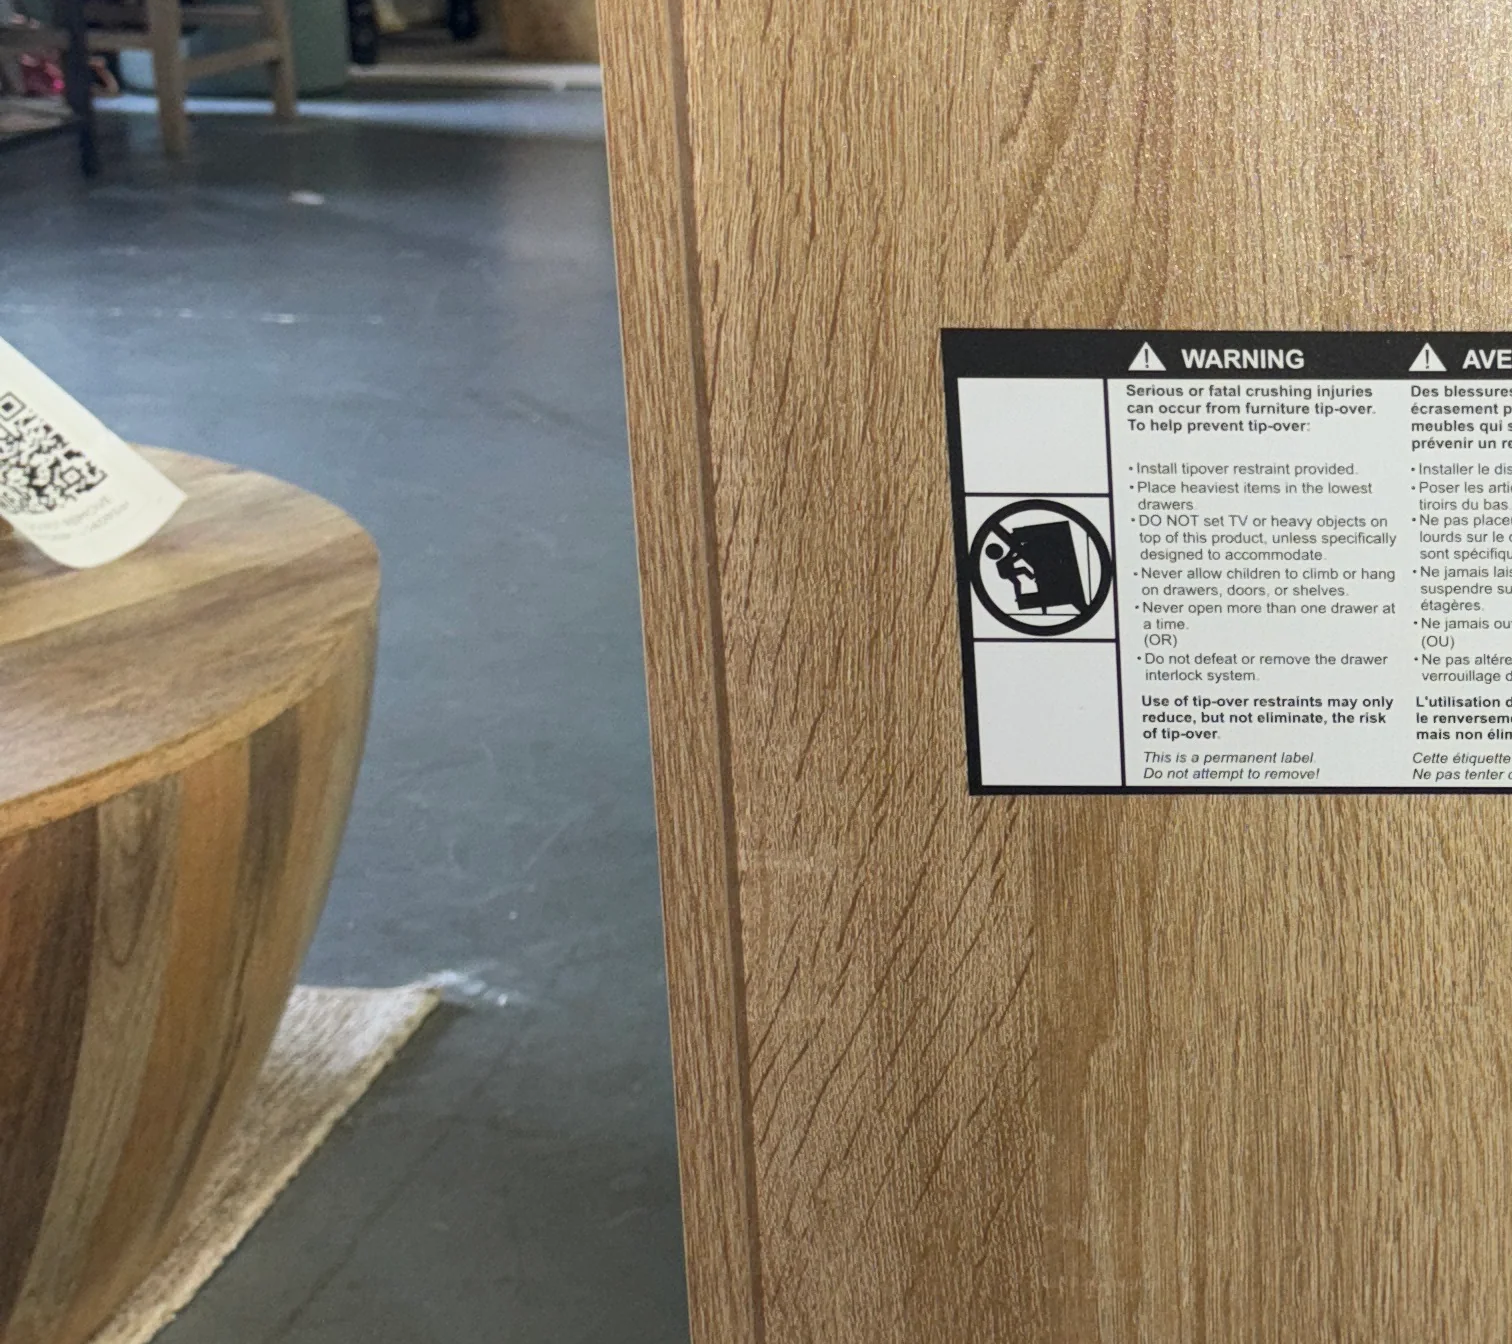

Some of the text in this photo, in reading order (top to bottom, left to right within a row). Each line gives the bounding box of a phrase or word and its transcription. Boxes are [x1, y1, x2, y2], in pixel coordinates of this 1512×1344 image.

[1180, 348, 1305, 370] WARNING
[1125, 383, 1374, 401] Serious or fatal crushing injuries
[1410, 384, 1440, 398] Des
[1410, 401, 1500, 416] écrasement
[1410, 419, 1476, 433] meubles
[1478, 418, 1504, 436] qui
[1136, 480, 1373, 495] Place heaviest items in the lowest
[1418, 480, 1461, 494] Poser
[1463, 481, 1485, 494] les
[1138, 513, 1388, 531] DO NOT set TV or heavy objects on
[1138, 530, 1398, 548] top of this product, unless specifically
[1140, 566, 1396, 583] Never allow children to climb or hang
[1143, 633, 1178, 649] (OR)
[1420, 634, 1456, 651] (OU)
[1141, 694, 1394, 711] Use of tip-over restraints may only
[1415, 695, 1502, 708] L'utilisation
[1142, 710, 1387, 726] reduce, but not eliminate, the risk
[1415, 711, 1429, 724] le
[1142, 766, 1321, 782] Do not attempt to remove!
[1412, 768, 1432, 781] Ne
[1434, 770, 1462, 783] pas
[1464, 768, 1506, 781] tenter
